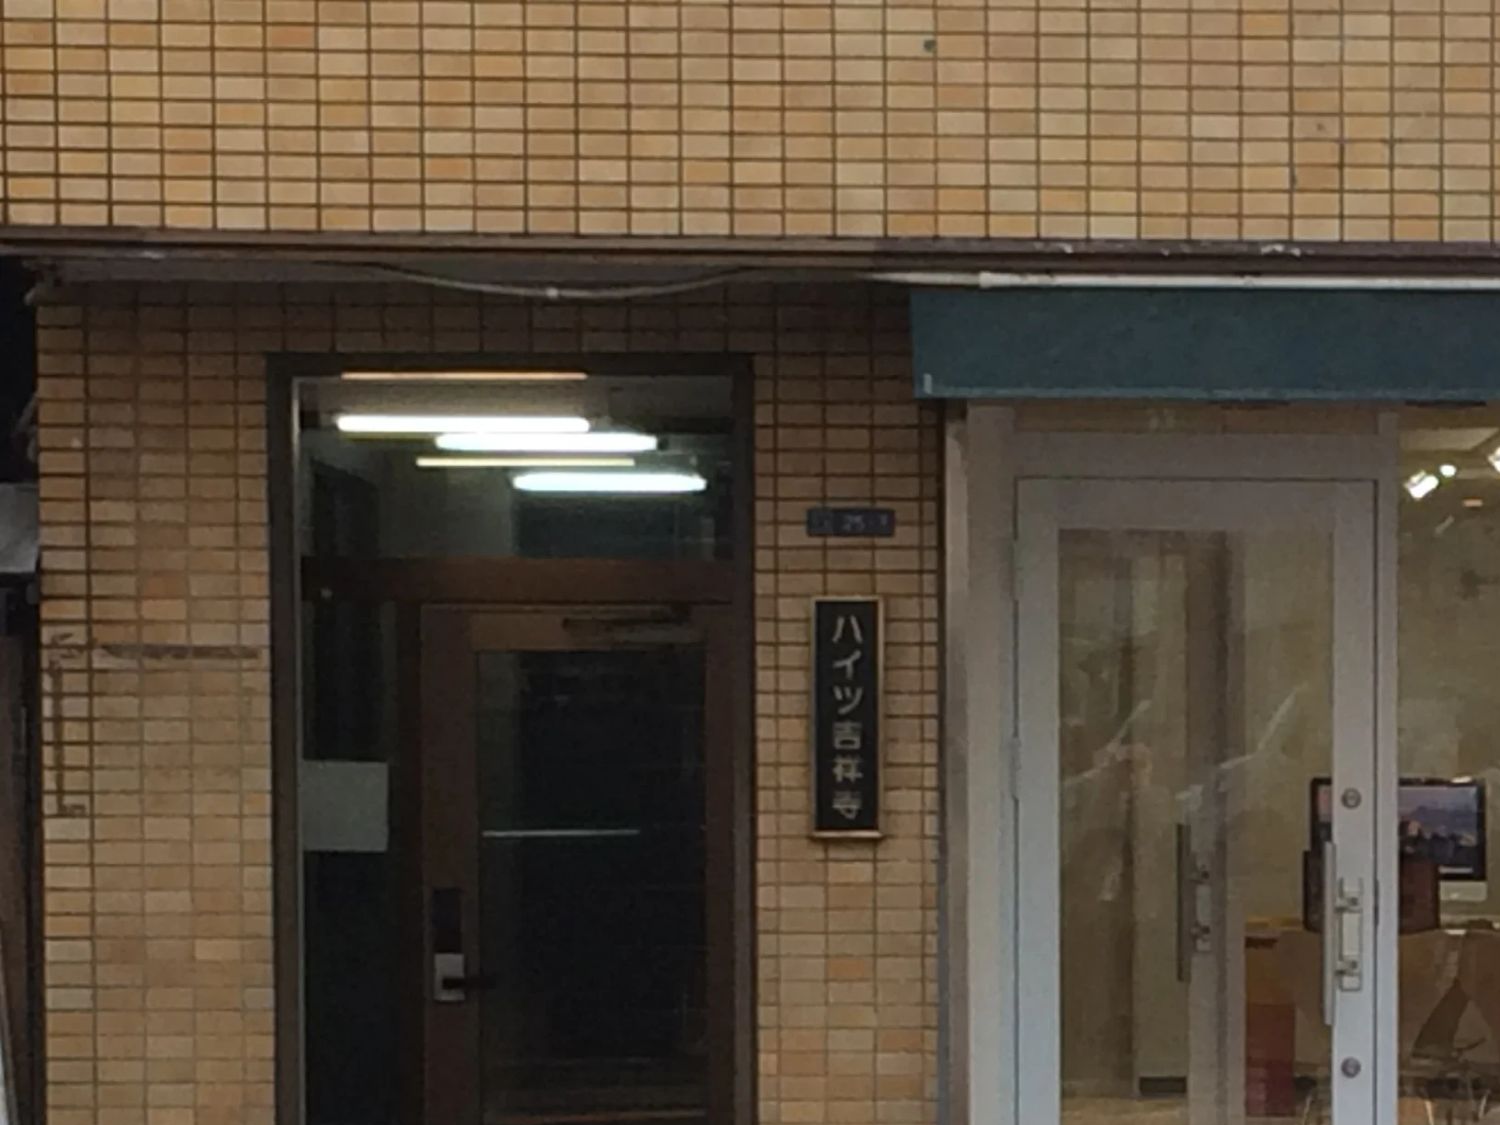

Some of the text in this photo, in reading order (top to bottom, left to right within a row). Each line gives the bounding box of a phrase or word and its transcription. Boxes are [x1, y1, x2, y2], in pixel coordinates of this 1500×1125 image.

[831, 614, 863, 819] ハイツ吉祥寺
